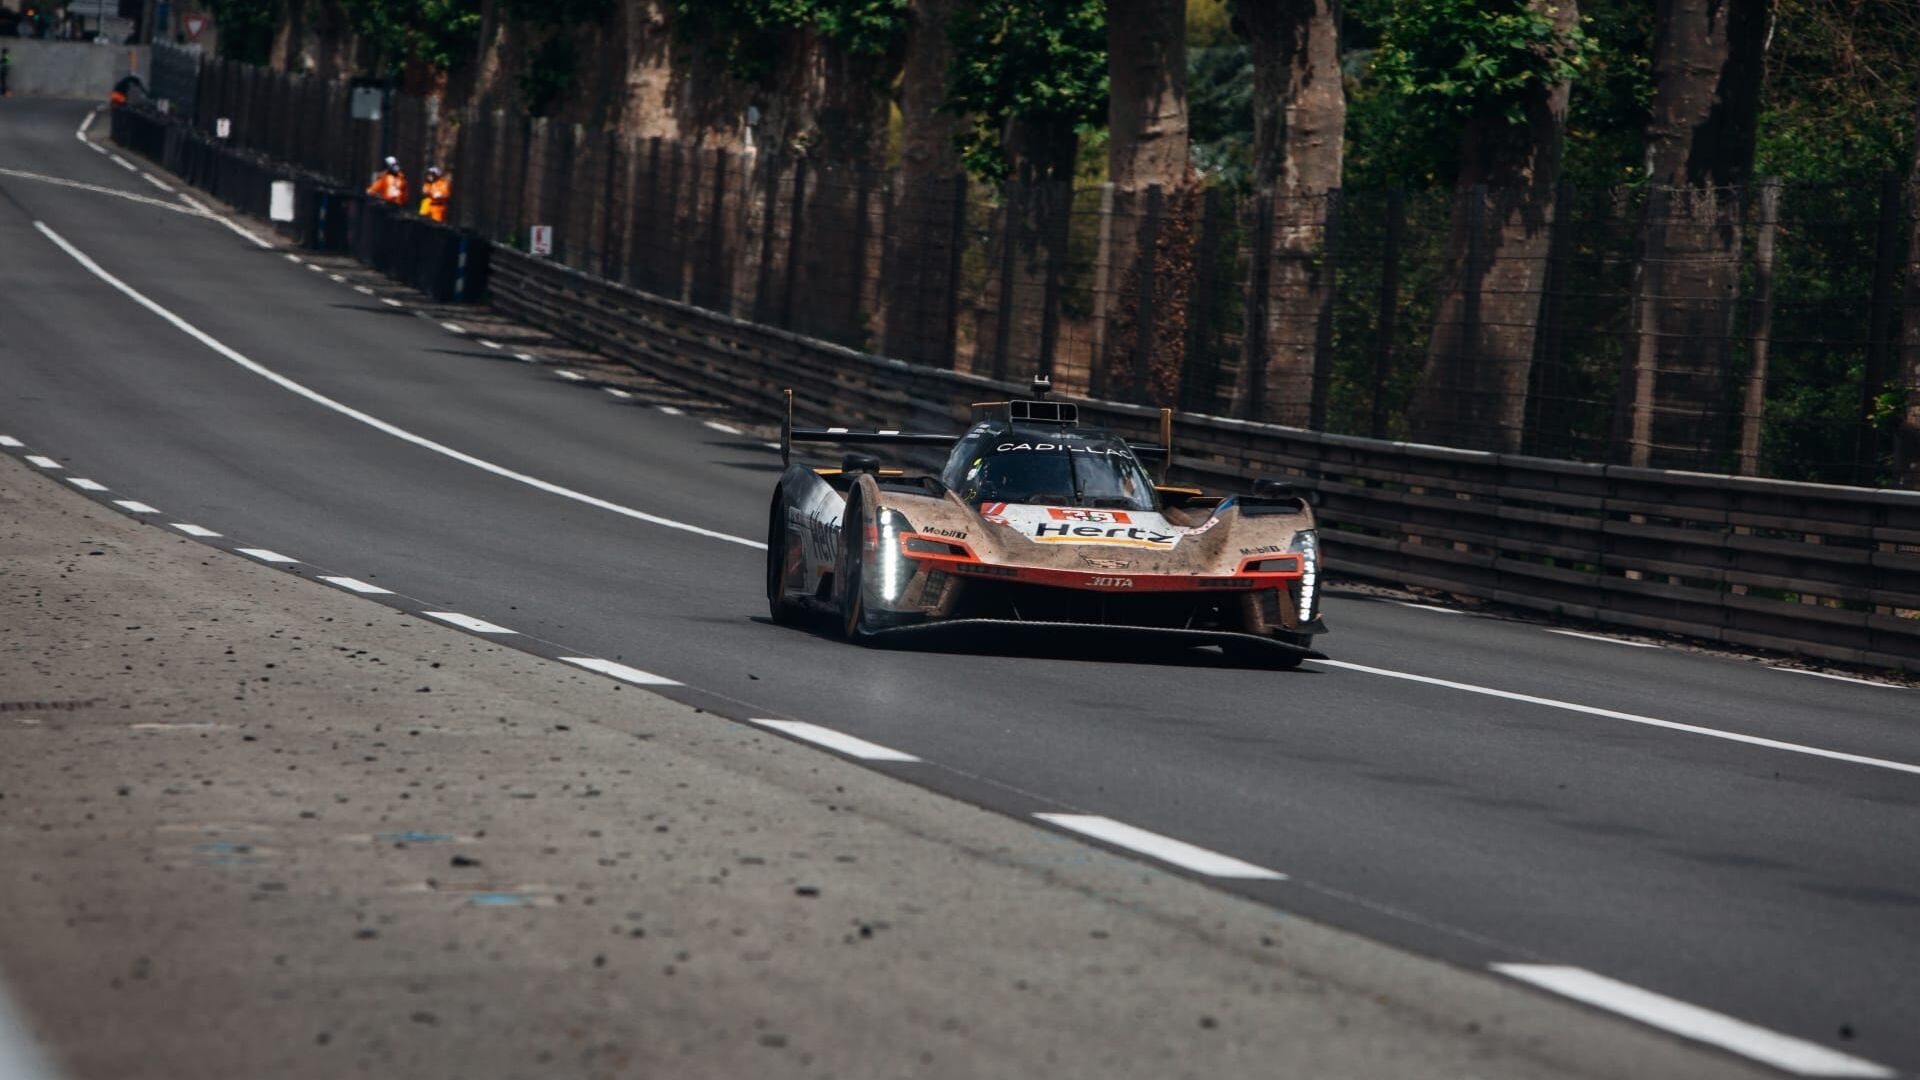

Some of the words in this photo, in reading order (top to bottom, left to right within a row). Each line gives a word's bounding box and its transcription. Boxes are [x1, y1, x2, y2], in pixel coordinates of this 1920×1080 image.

[996, 442, 1133, 459] CADILLAC
[810, 510, 843, 562] Hert
[1035, 524, 1175, 544] Hertz
